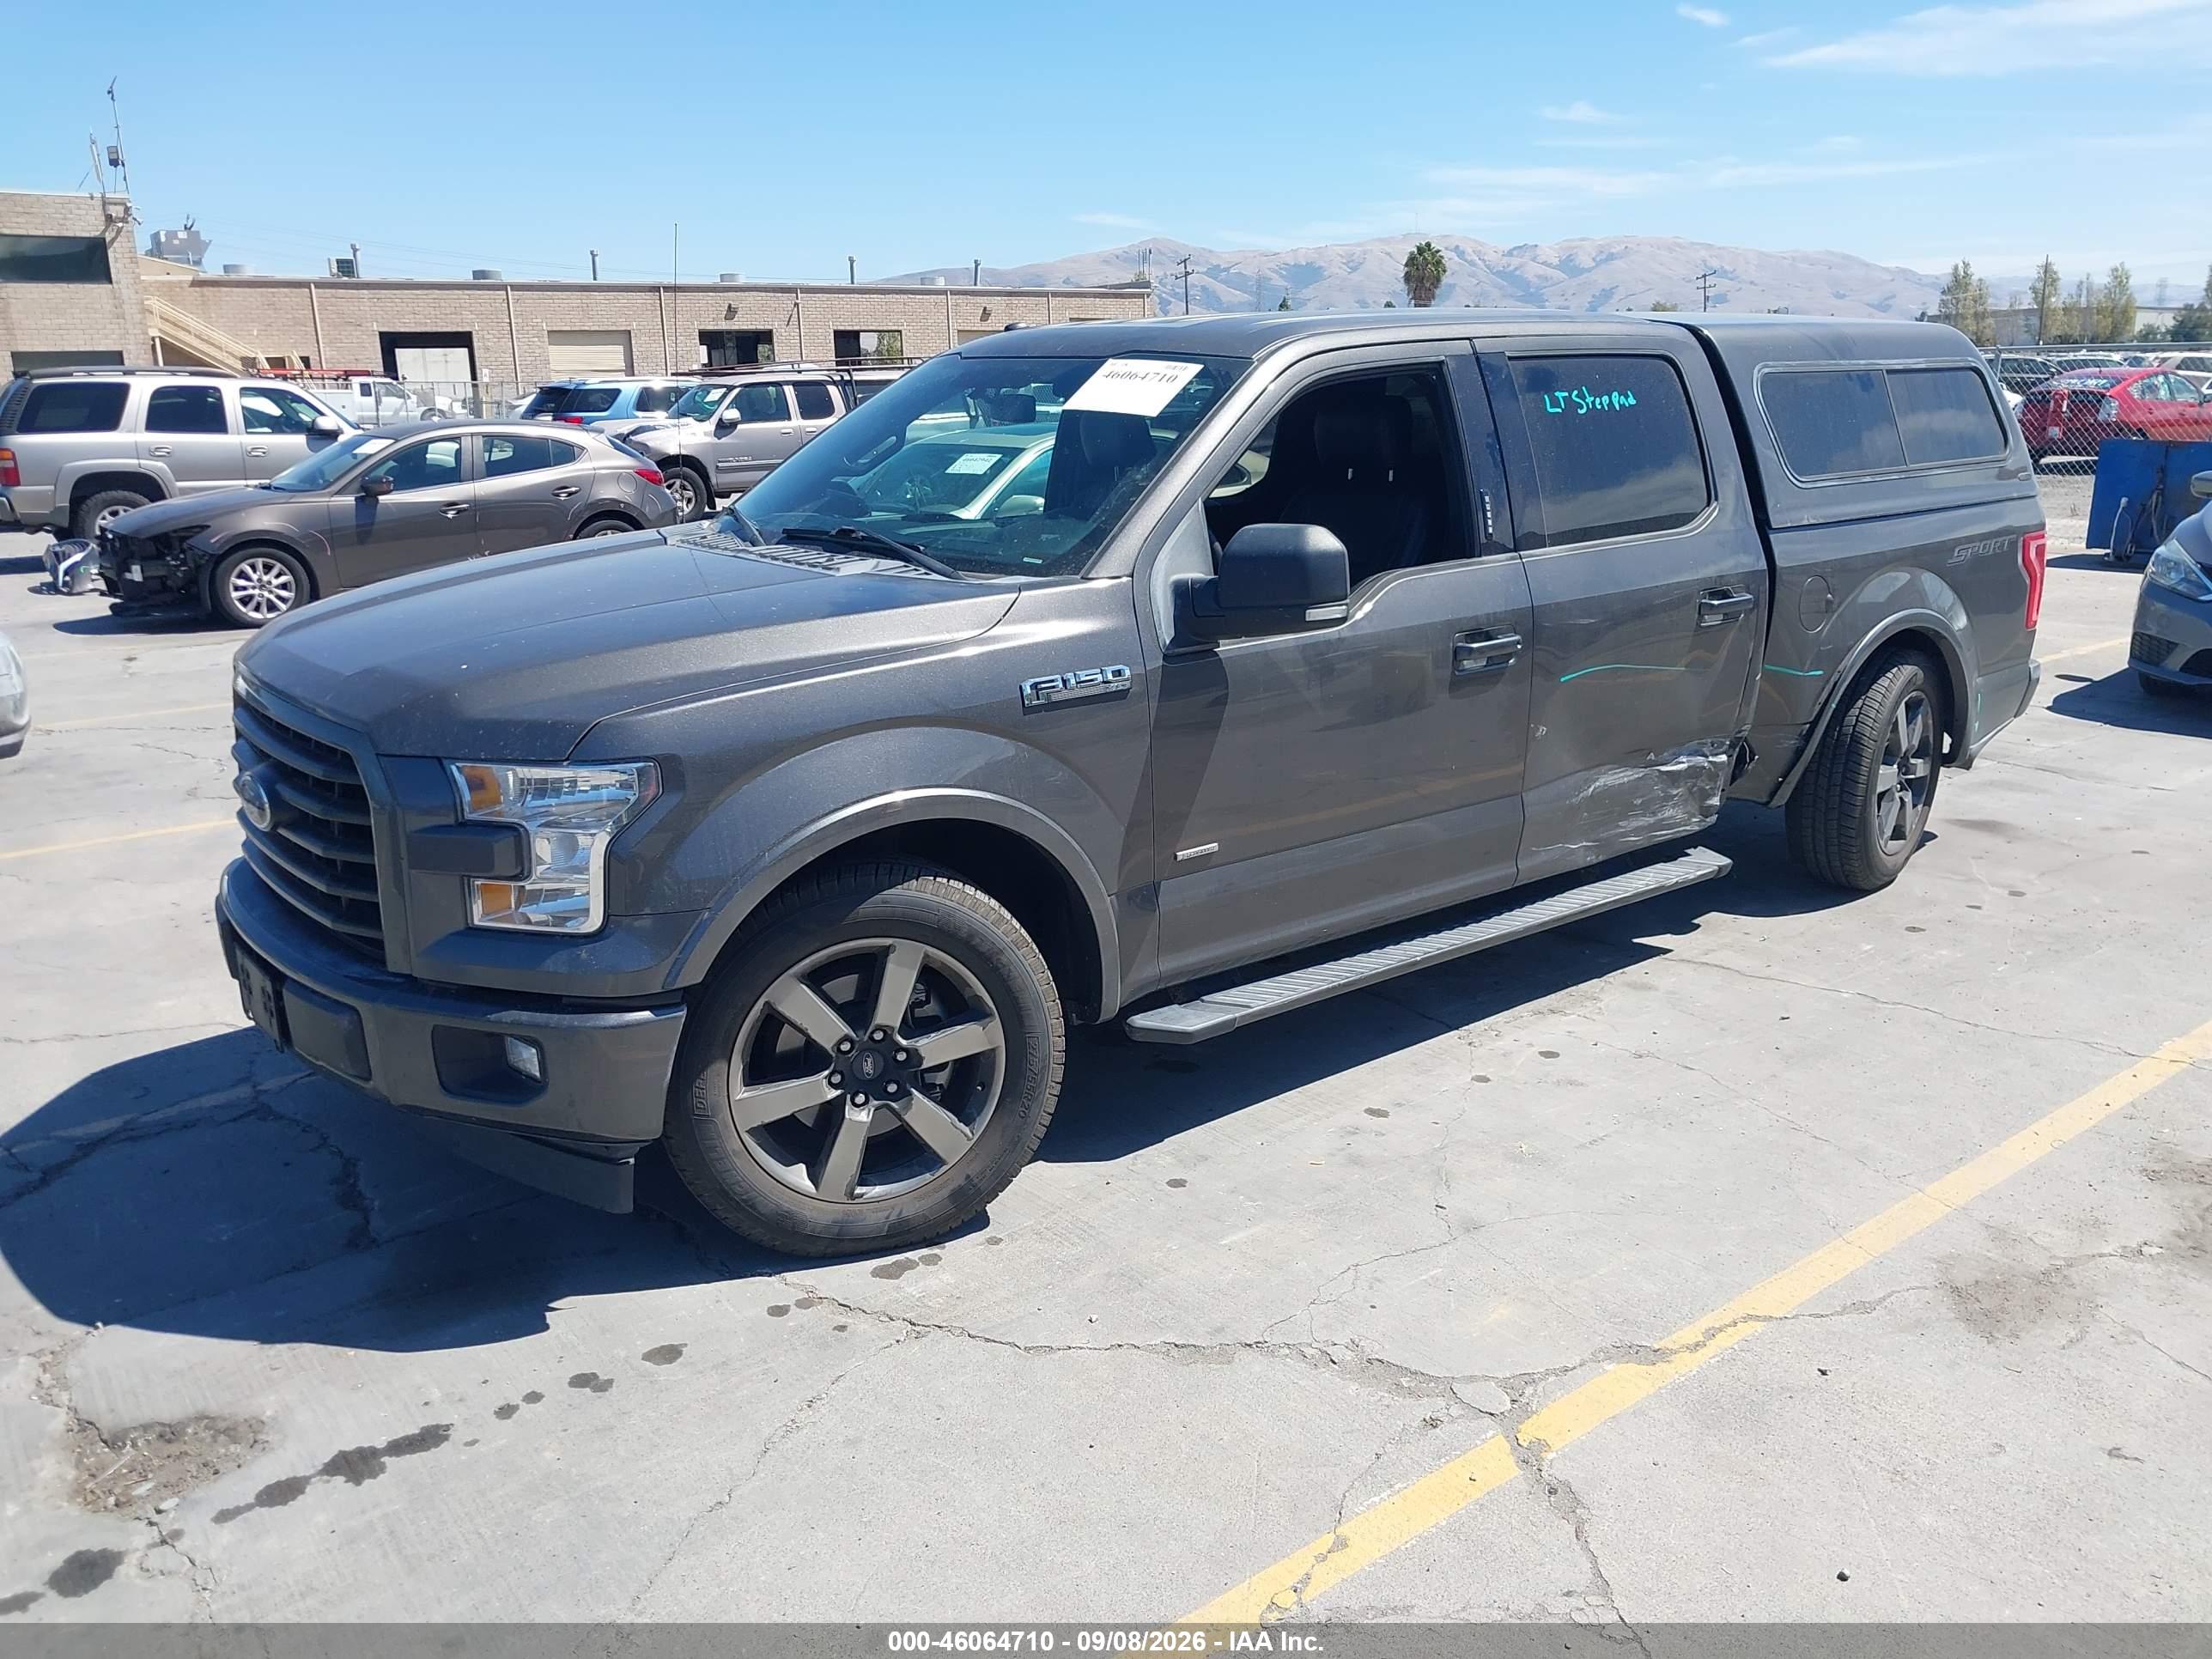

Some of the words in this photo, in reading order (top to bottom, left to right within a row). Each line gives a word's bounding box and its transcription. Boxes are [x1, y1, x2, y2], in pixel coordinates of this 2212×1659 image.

[1102, 370, 1179, 384] 46064710
[1946, 534, 2017, 567] SPORT
[1020, 664, 1132, 708] F150
